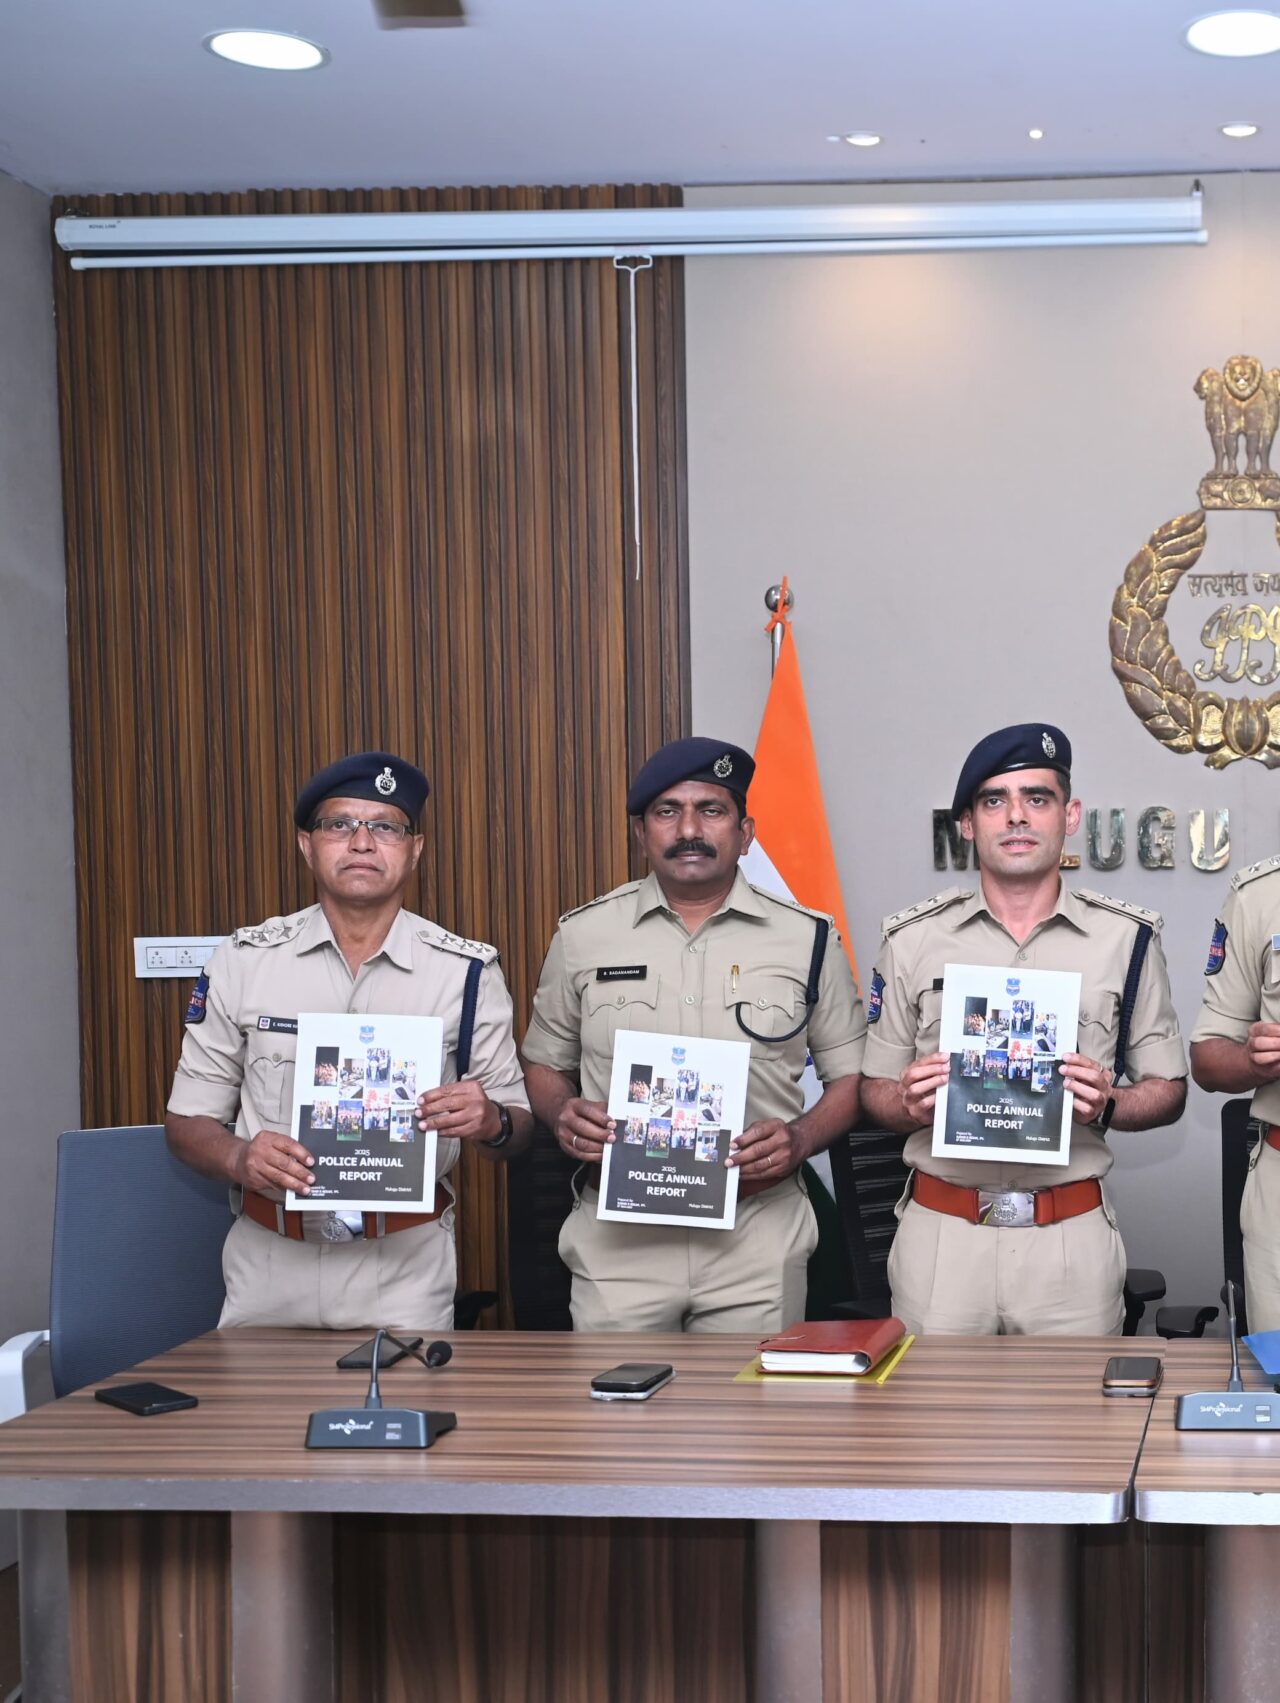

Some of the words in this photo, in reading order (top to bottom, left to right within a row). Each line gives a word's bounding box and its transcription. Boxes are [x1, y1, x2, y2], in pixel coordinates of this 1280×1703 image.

[932, 806, 1230, 872] MUGU
[966, 1103, 1002, 1114] POLICE
[1003, 1106, 1043, 1117] ANNUAL
[984, 1118, 1024, 1130] REPORT
[318, 1156, 357, 1166] POLICE
[360, 1157, 404, 1167] ANNUAL
[339, 1171, 383, 1181] REPORT
[628, 1170, 664, 1182] POLICE
[666, 1174, 707, 1185] ANNUAL
[646, 1186, 687, 1198] REPORT
